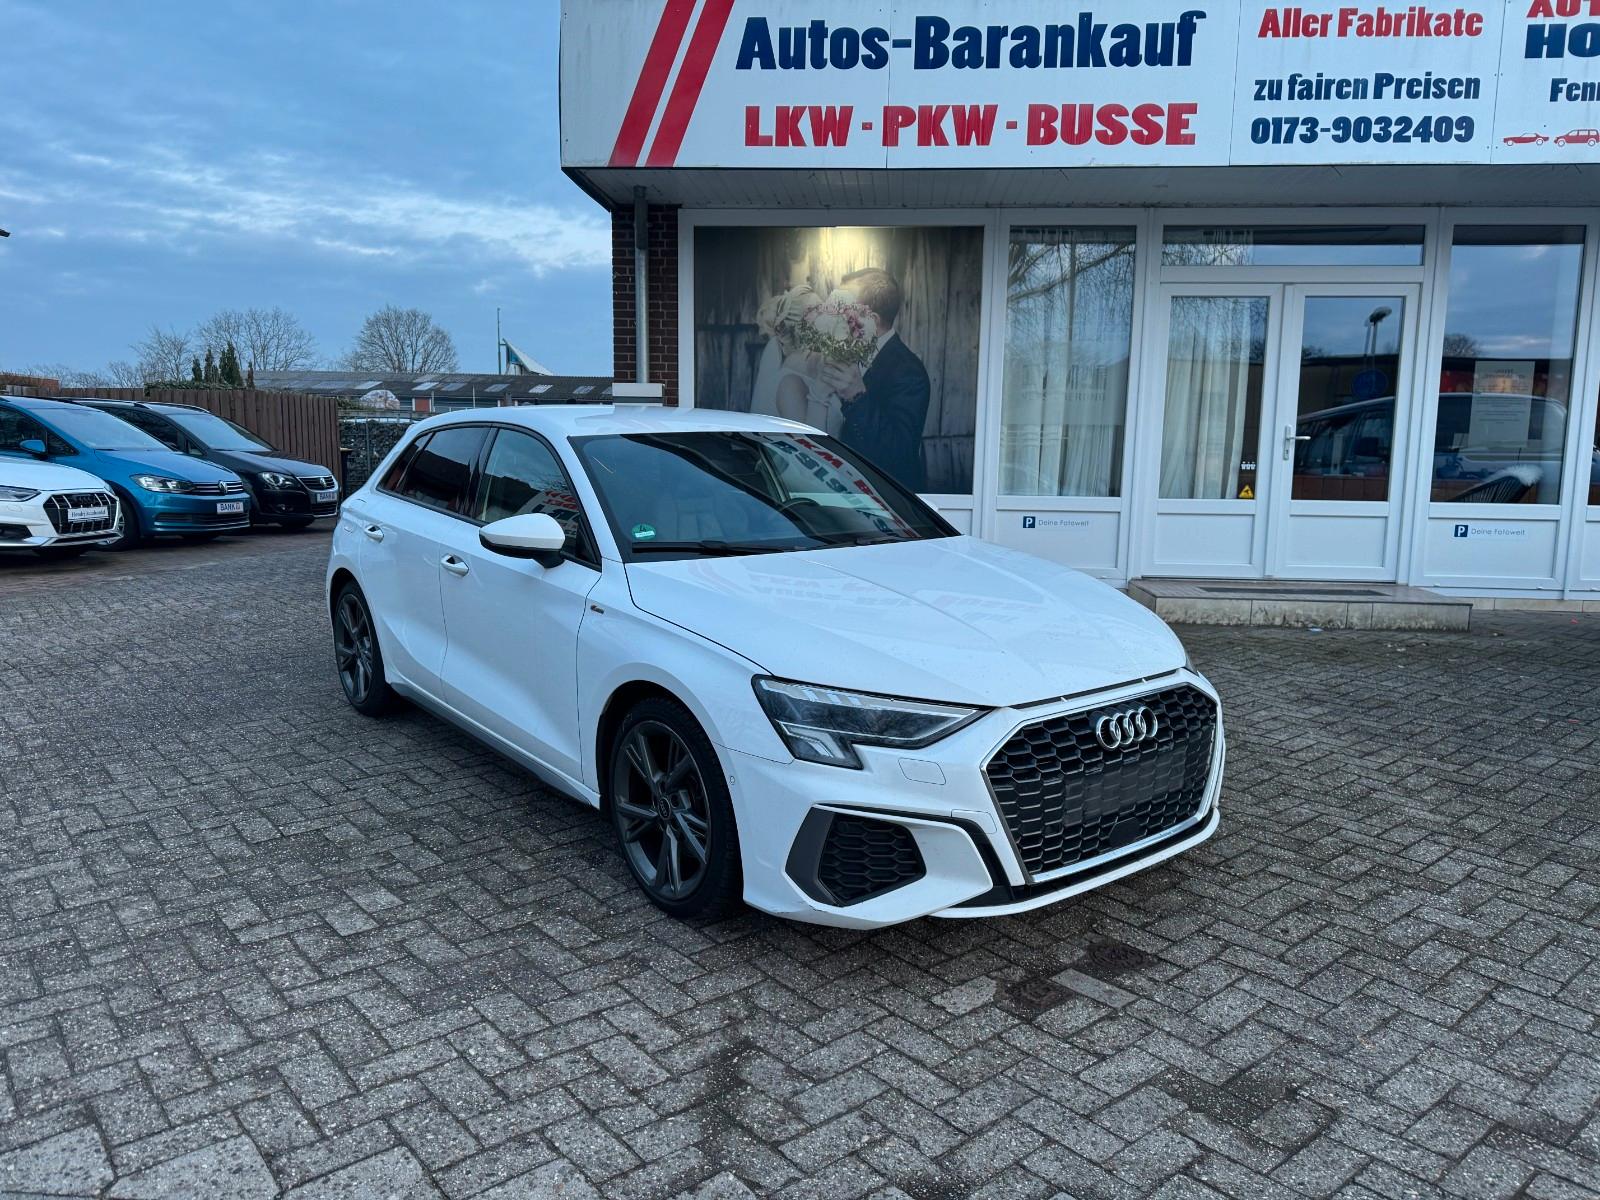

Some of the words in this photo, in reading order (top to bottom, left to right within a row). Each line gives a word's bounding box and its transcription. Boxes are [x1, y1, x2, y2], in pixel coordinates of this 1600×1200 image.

[1258, 8, 1333, 38] Aller
[1337, 7, 1484, 38] Fabrikate
[735, 10, 1207, 70] Autos-Barankauf
[1254, 79, 1283, 101] zu
[1287, 72, 1369, 101] fairen
[1373, 71, 1481, 100] Preisen
[1549, 77, 1600, 102] Fen
[745, 105, 854, 147] LKW
[882, 104, 999, 147] PKW
[1027, 103, 1198, 146] BUSSE
[1250, 115, 1475, 145] 0173-9032409
